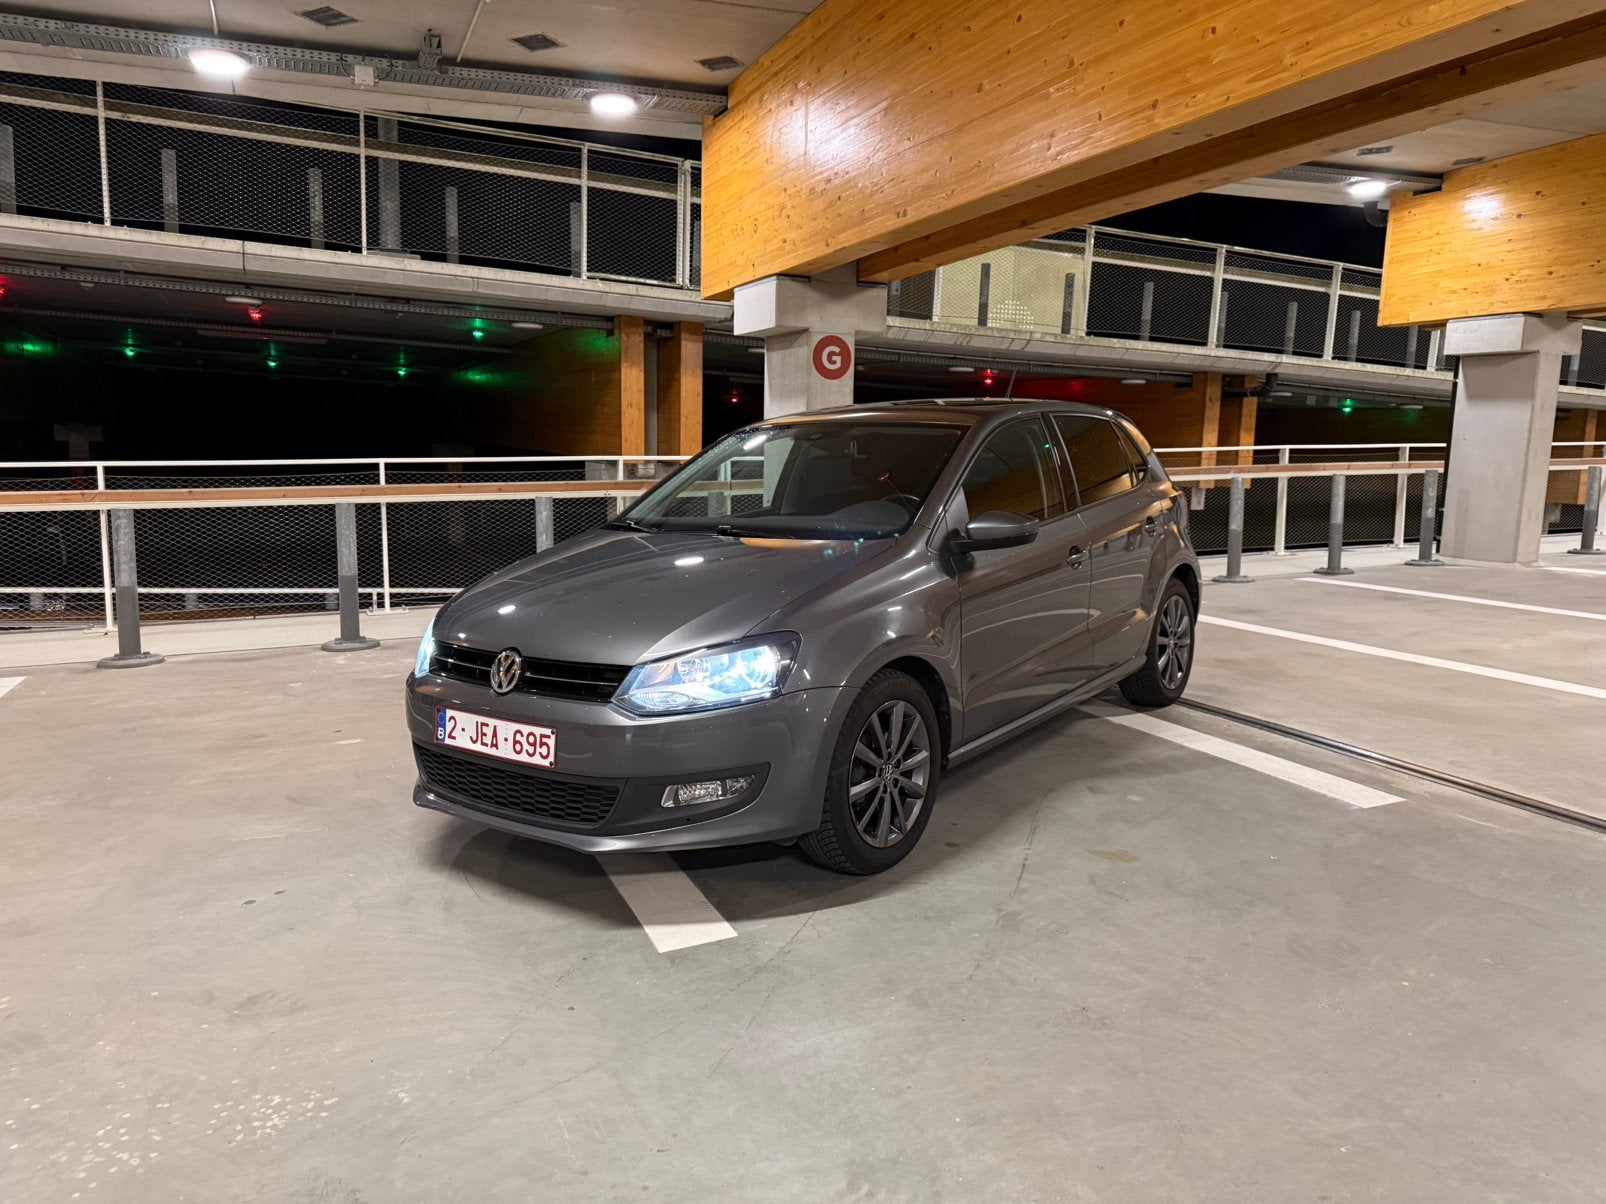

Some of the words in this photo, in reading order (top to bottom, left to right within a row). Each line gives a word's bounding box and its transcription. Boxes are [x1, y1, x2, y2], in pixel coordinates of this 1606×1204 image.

[821, 345, 842, 370] G
[437, 727, 445, 739] B
[447, 715, 551, 760] 2-JEA-695
